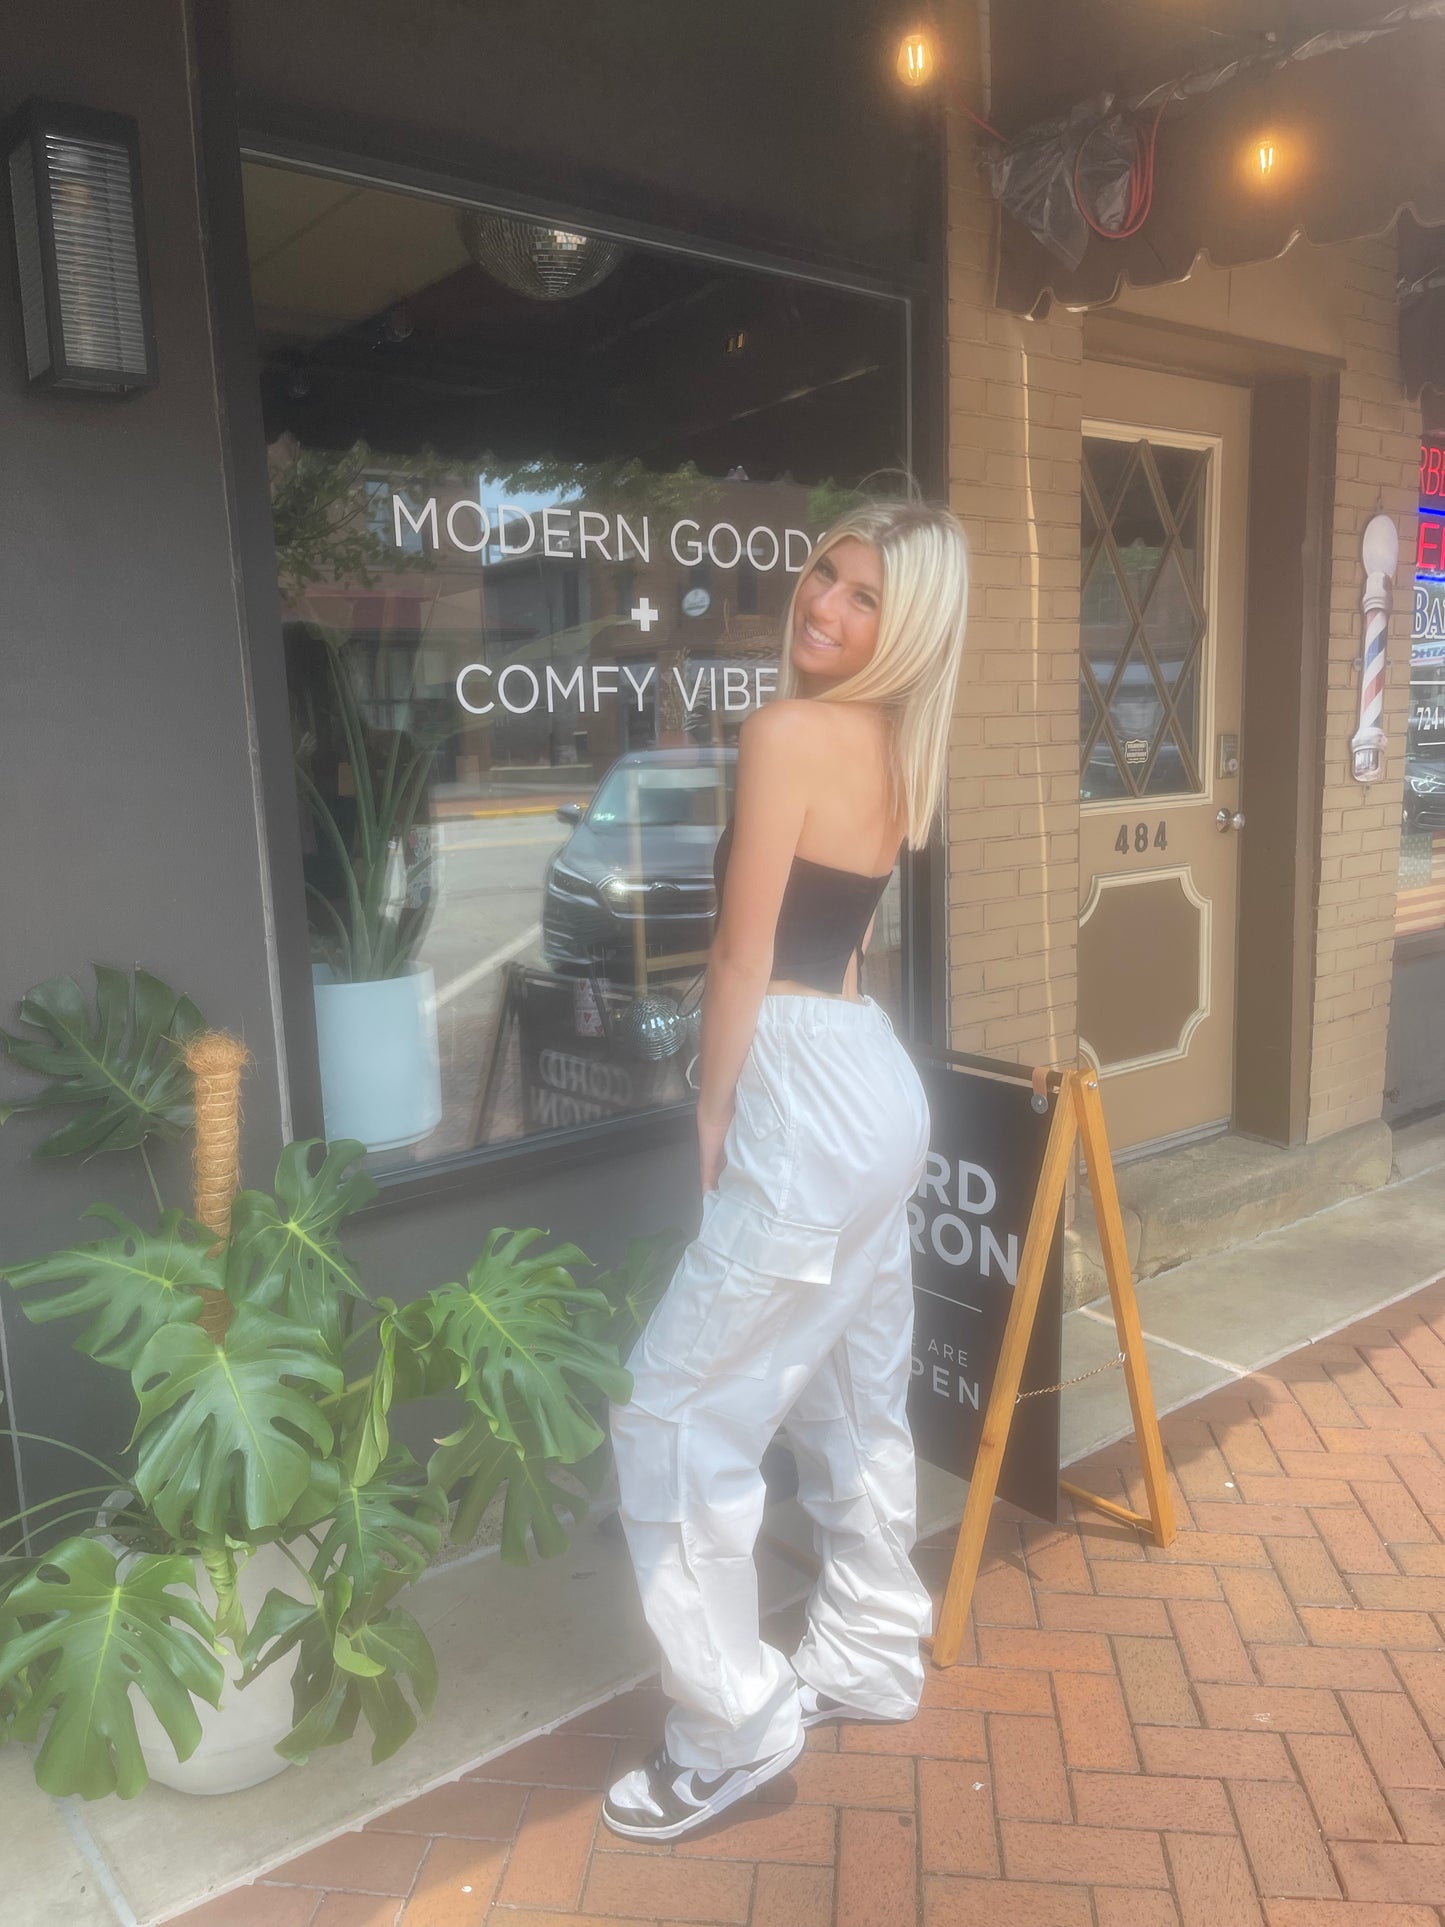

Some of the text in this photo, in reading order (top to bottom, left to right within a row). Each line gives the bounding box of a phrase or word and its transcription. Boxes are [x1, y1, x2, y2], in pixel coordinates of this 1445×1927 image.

[393, 495, 826, 573] MODERN GOOD
[1411, 585, 1445, 639] BA
[456, 663, 778, 715] COMFY VIBE
[1416, 706, 1445, 733] 724-
[1114, 820, 1168, 855] 484
[917, 1150, 997, 1215] RD
[905, 1201, 1018, 1286] RON
[927, 1338, 968, 1368] ARE
[911, 1355, 979, 1411] PEN
